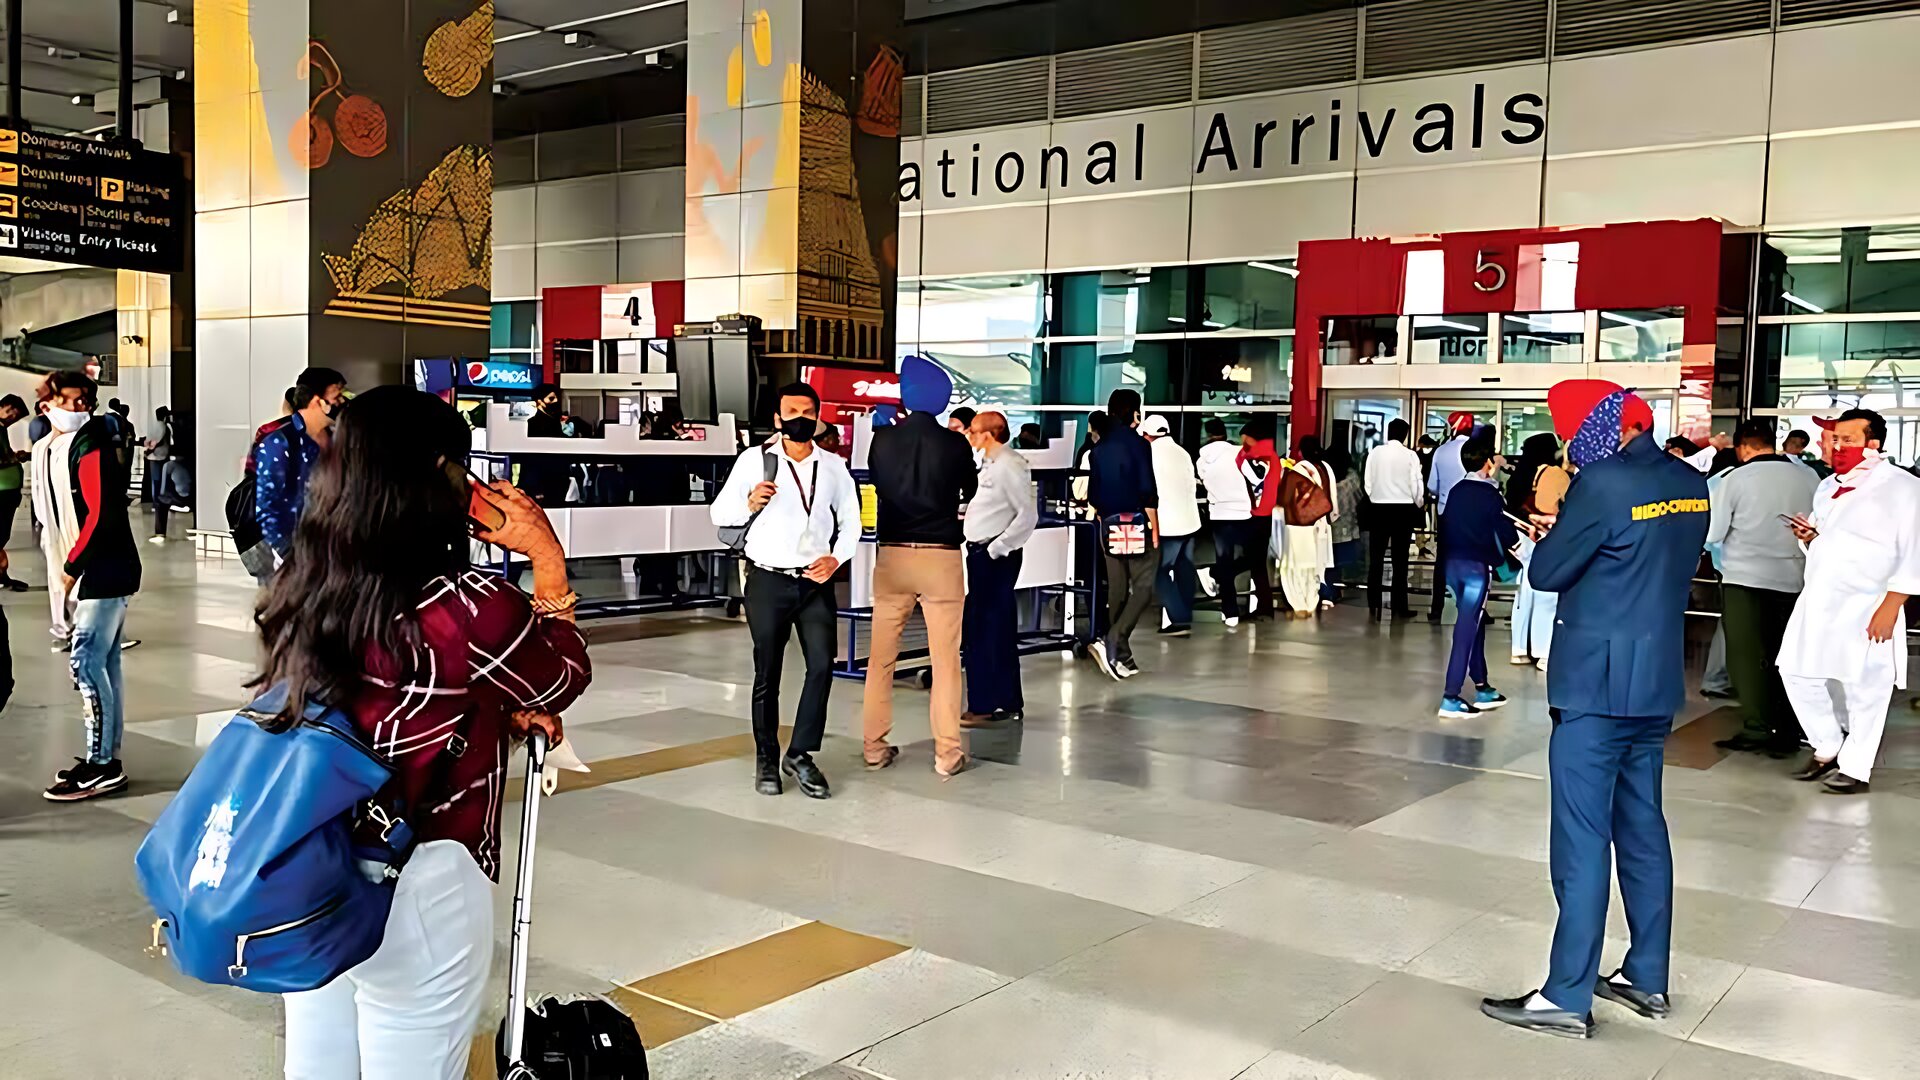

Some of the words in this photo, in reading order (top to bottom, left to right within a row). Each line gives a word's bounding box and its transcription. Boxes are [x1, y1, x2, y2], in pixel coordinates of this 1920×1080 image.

[1196, 83, 1546, 174] Arrivals
[21, 132, 82, 153] Domestic
[86, 143, 131, 160] Arrivals
[21, 164, 92, 187] Departures
[106, 181, 119, 197] P
[86, 205, 130, 222] Shuttle
[79, 233, 112, 250] Entry
[114, 237, 157, 253] Tickets
[1473, 249, 1506, 292] 5
[621, 296, 642, 326] 4
[490, 368, 532, 385] pepsi
